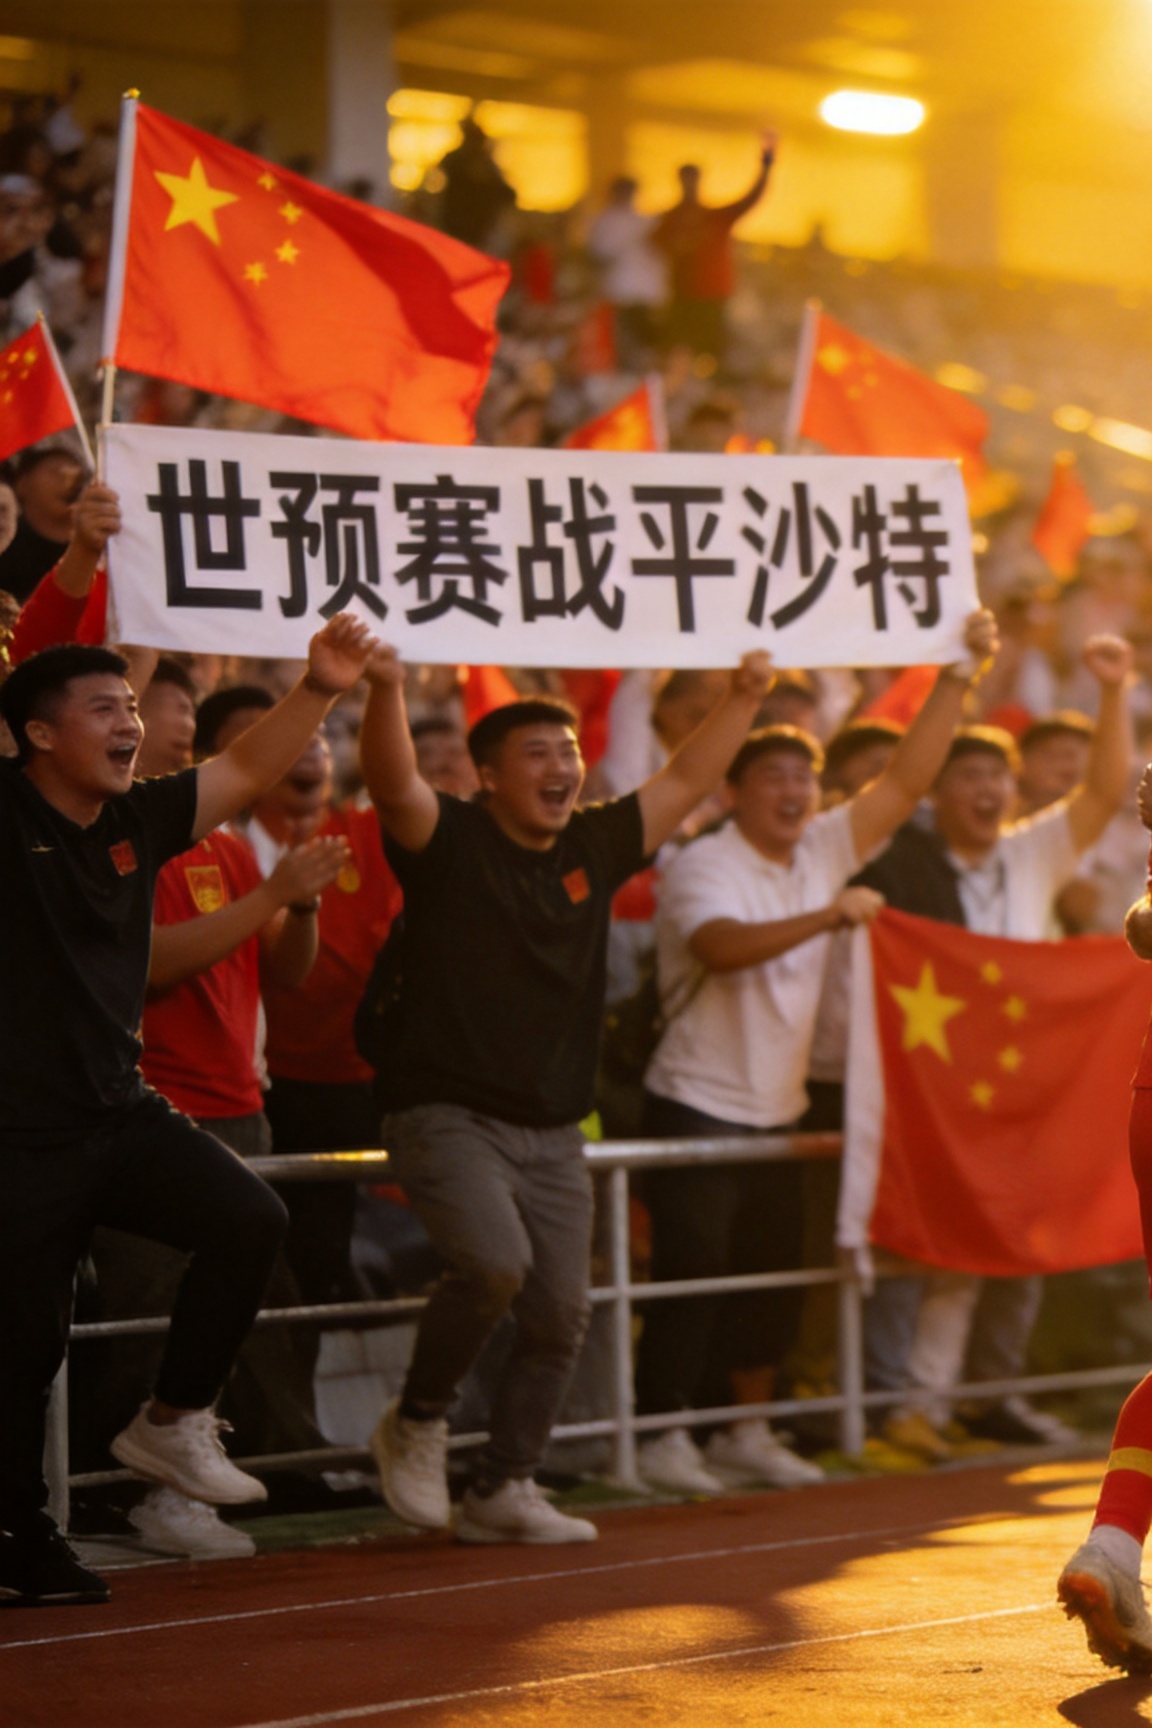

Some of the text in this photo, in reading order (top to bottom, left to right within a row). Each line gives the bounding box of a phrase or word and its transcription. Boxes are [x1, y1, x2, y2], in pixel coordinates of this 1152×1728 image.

[146, 458, 951, 633] 世预赛战平沙特
